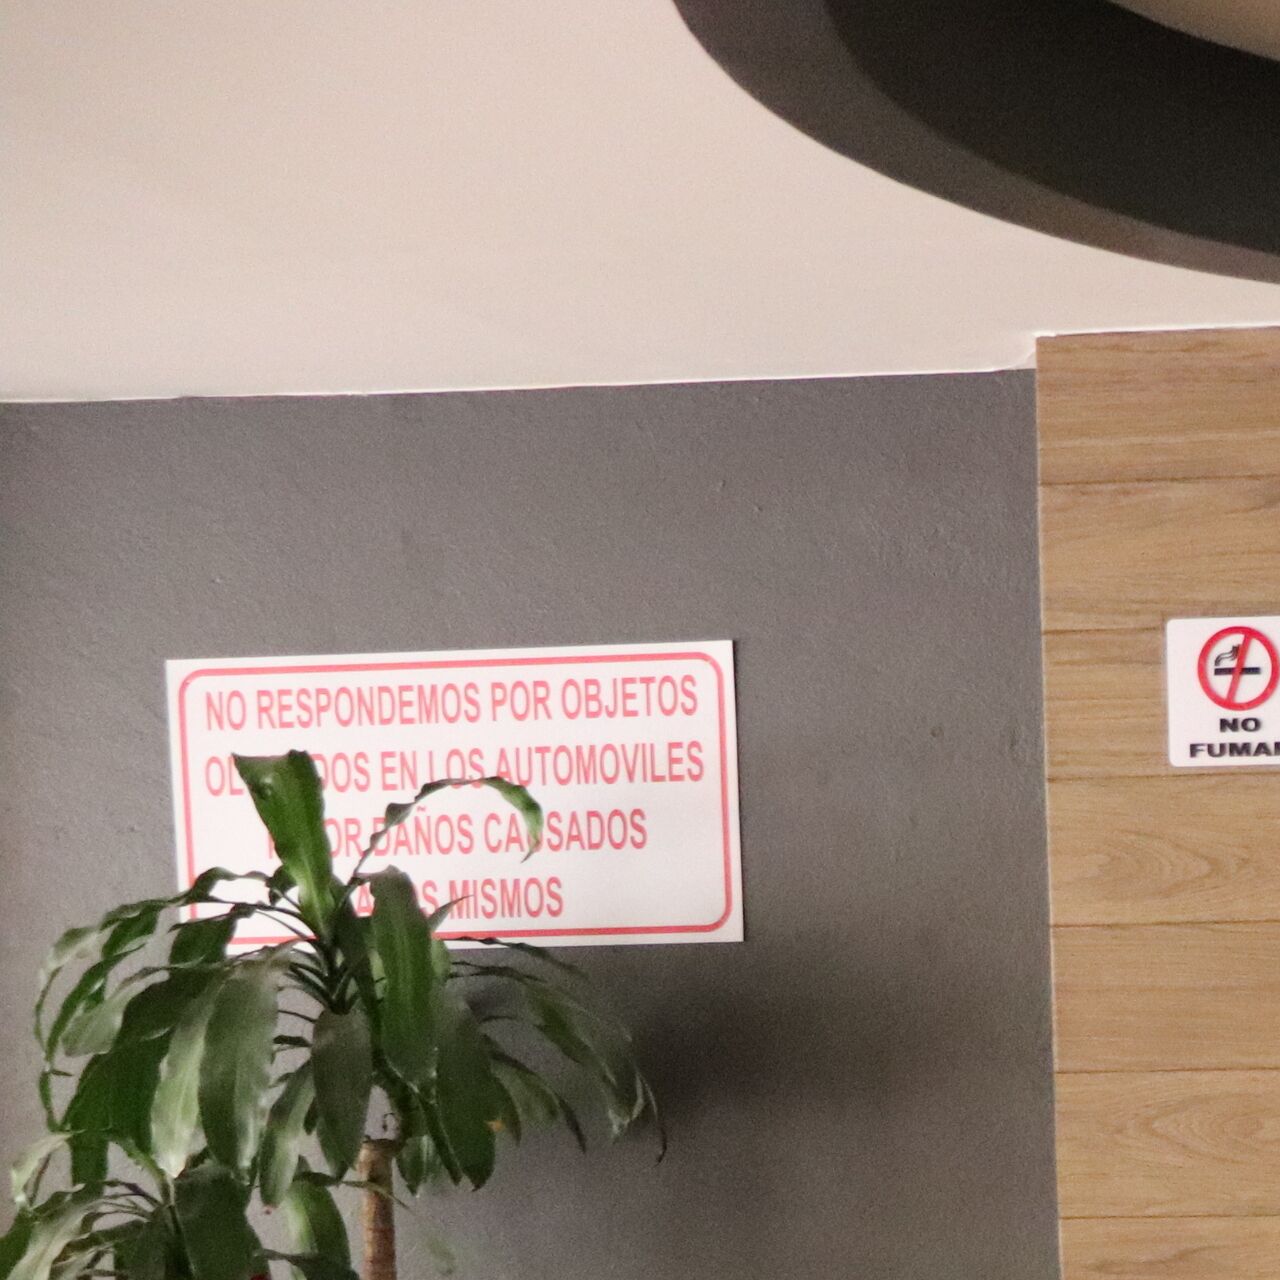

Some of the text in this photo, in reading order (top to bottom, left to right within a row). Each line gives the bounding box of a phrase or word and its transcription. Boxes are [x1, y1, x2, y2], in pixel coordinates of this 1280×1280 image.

[205, 674, 698, 731] NO RESPONDEMOS POR OBJETOS
[1219, 717, 1262, 733] NO
[380, 751, 418, 792] EN
[428, 747, 485, 789] LOS
[495, 740, 705, 787] AUTOMOVILES
[322, 817, 365, 858] OR
[372, 806, 475, 857] DAÑOS
[449, 875, 564, 920] MISMOS
